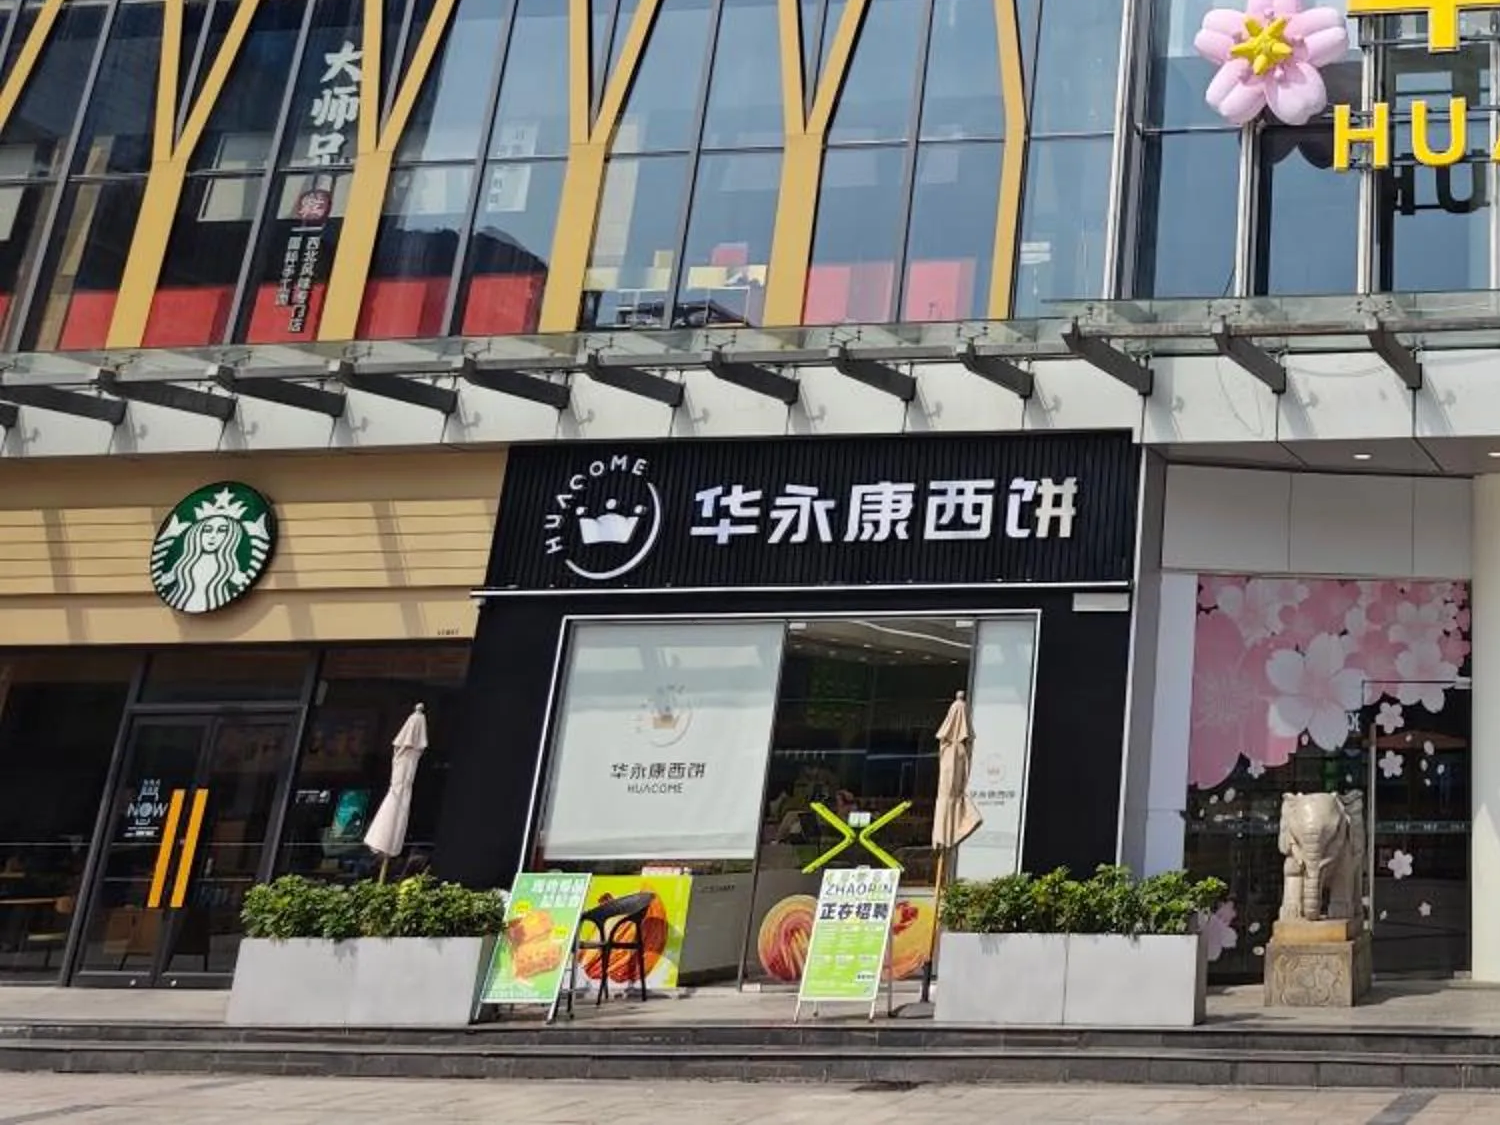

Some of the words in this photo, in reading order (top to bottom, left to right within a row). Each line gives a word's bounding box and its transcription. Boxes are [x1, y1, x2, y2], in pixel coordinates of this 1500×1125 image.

[543, 454, 648, 554] HUACOME
[690, 475, 1077, 545] 华永康西饼
[609, 761, 707, 780] 华永康西饼
[818, 901, 890, 921] 正在招聘
